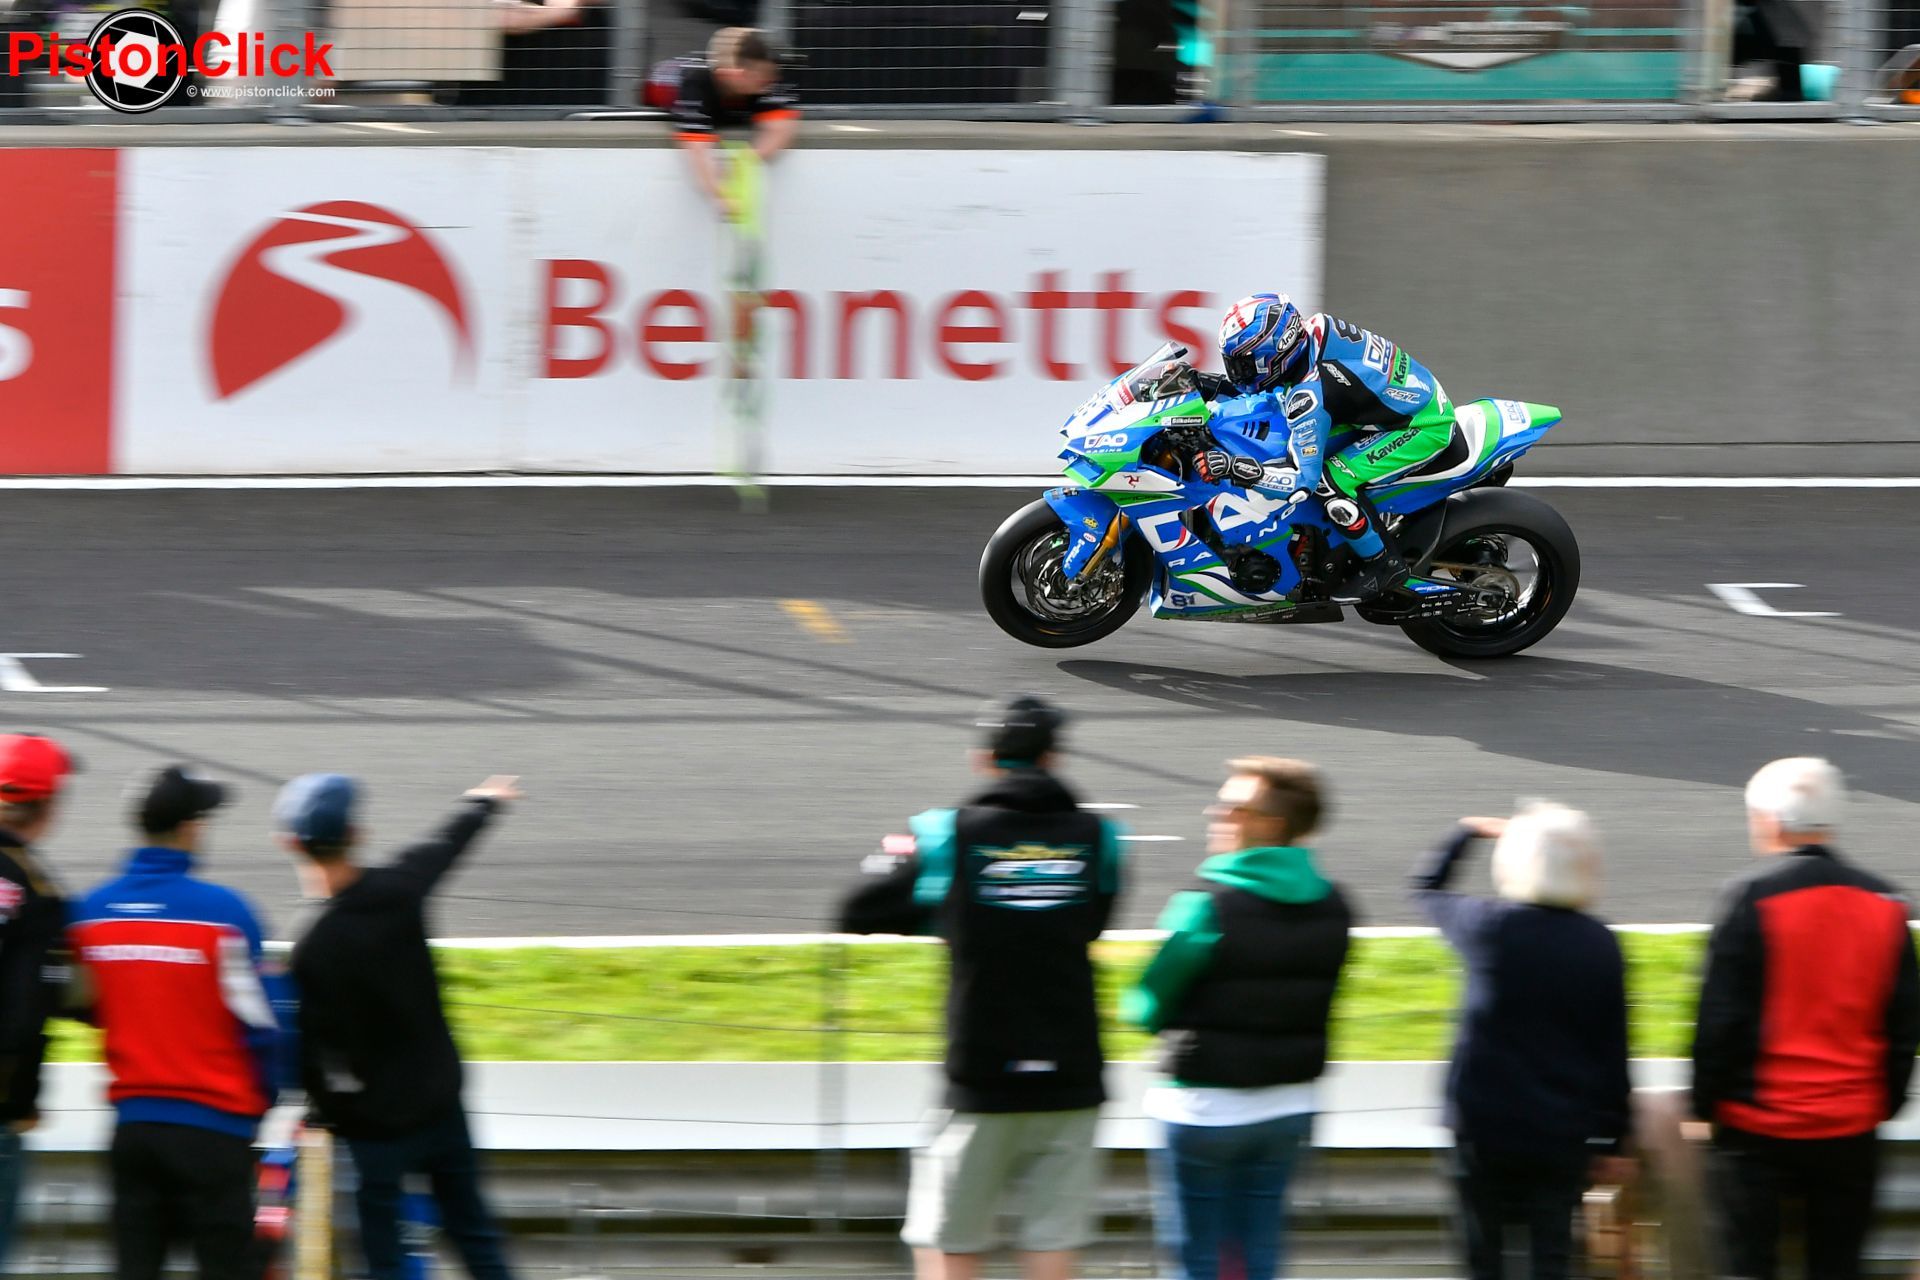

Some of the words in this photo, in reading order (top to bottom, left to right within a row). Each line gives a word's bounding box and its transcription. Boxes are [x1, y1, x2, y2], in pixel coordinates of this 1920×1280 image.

[535, 258, 1215, 382] Bennetts
[1278, 327, 1298, 350] Arai
[1382, 387, 1421, 401] RST
[1083, 433, 1128, 449] DAO
